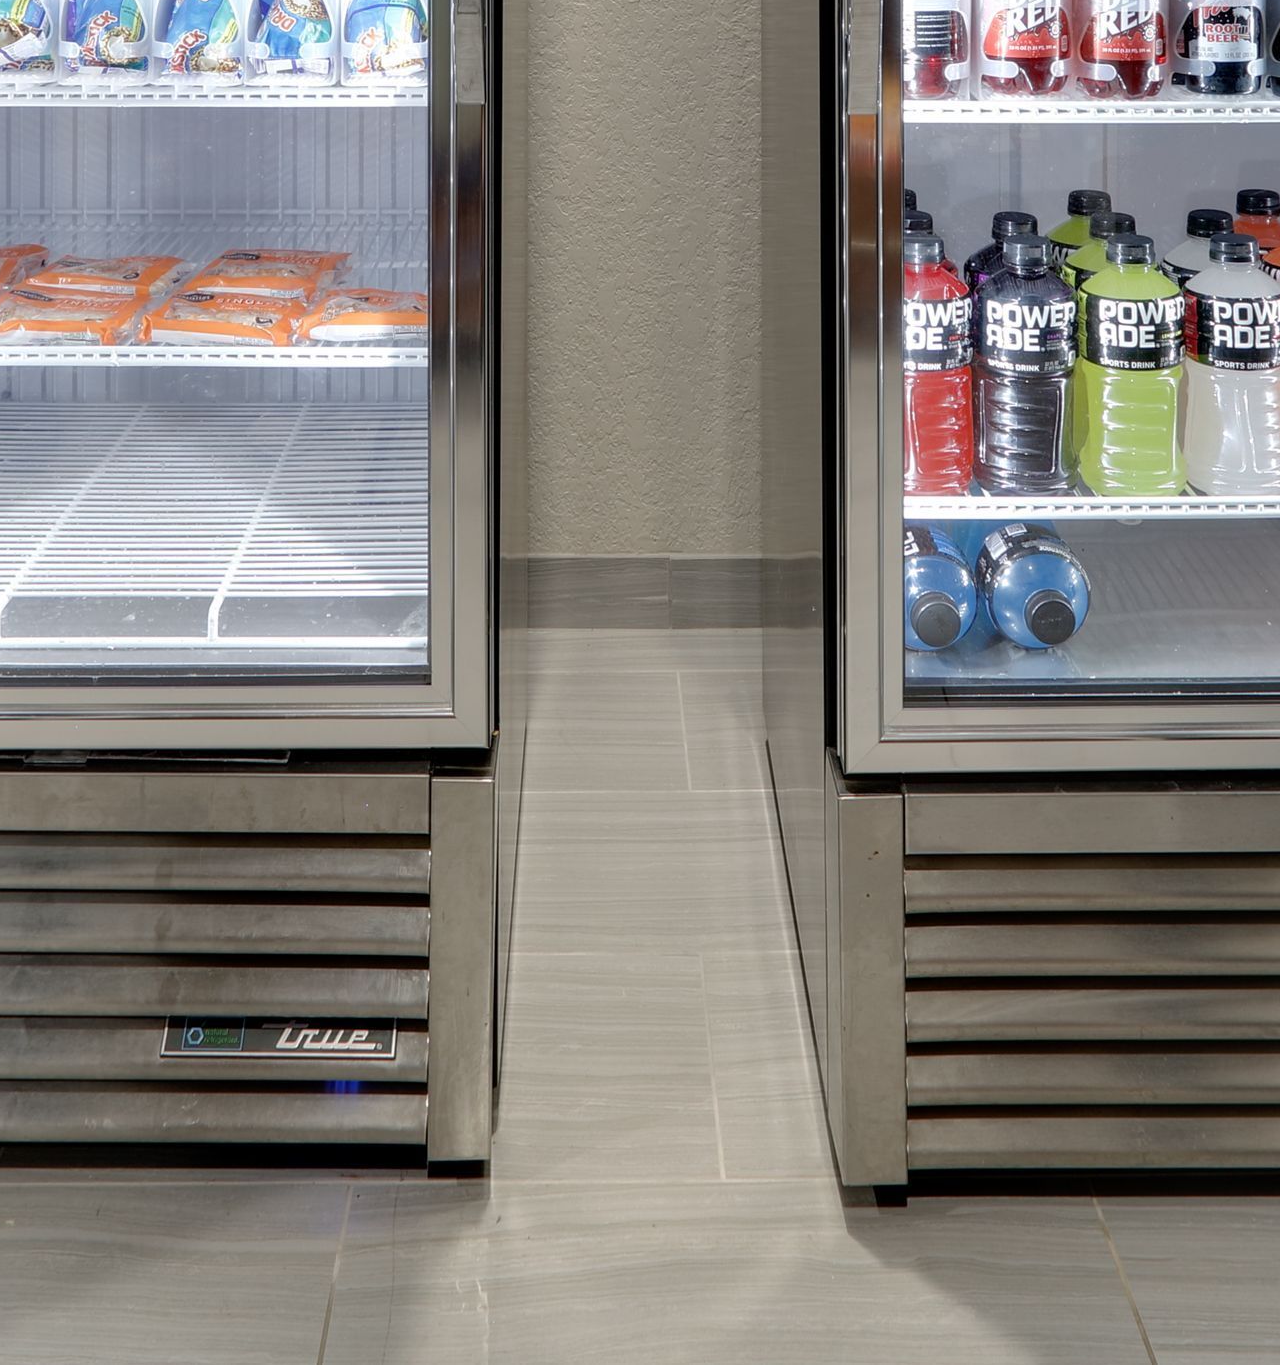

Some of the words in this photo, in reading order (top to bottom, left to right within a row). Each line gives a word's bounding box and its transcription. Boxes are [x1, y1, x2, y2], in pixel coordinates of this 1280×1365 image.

[1205, 24, 1240, 33] ROOT
[1207, 34, 1240, 43] BEER
[987, 300, 1076, 328] POWER
[1098, 297, 1185, 325] POWER
[904, 327, 944, 351] DE
[918, 362, 942, 371] DRINK
[1015, 364, 1040, 372] DRINK
[1099, 357, 1130, 369] SPORTS
[1131, 361, 1156, 369] DRINK
[1215, 360, 1246, 369] SPORTS
[1247, 361, 1271, 370] DRINK
